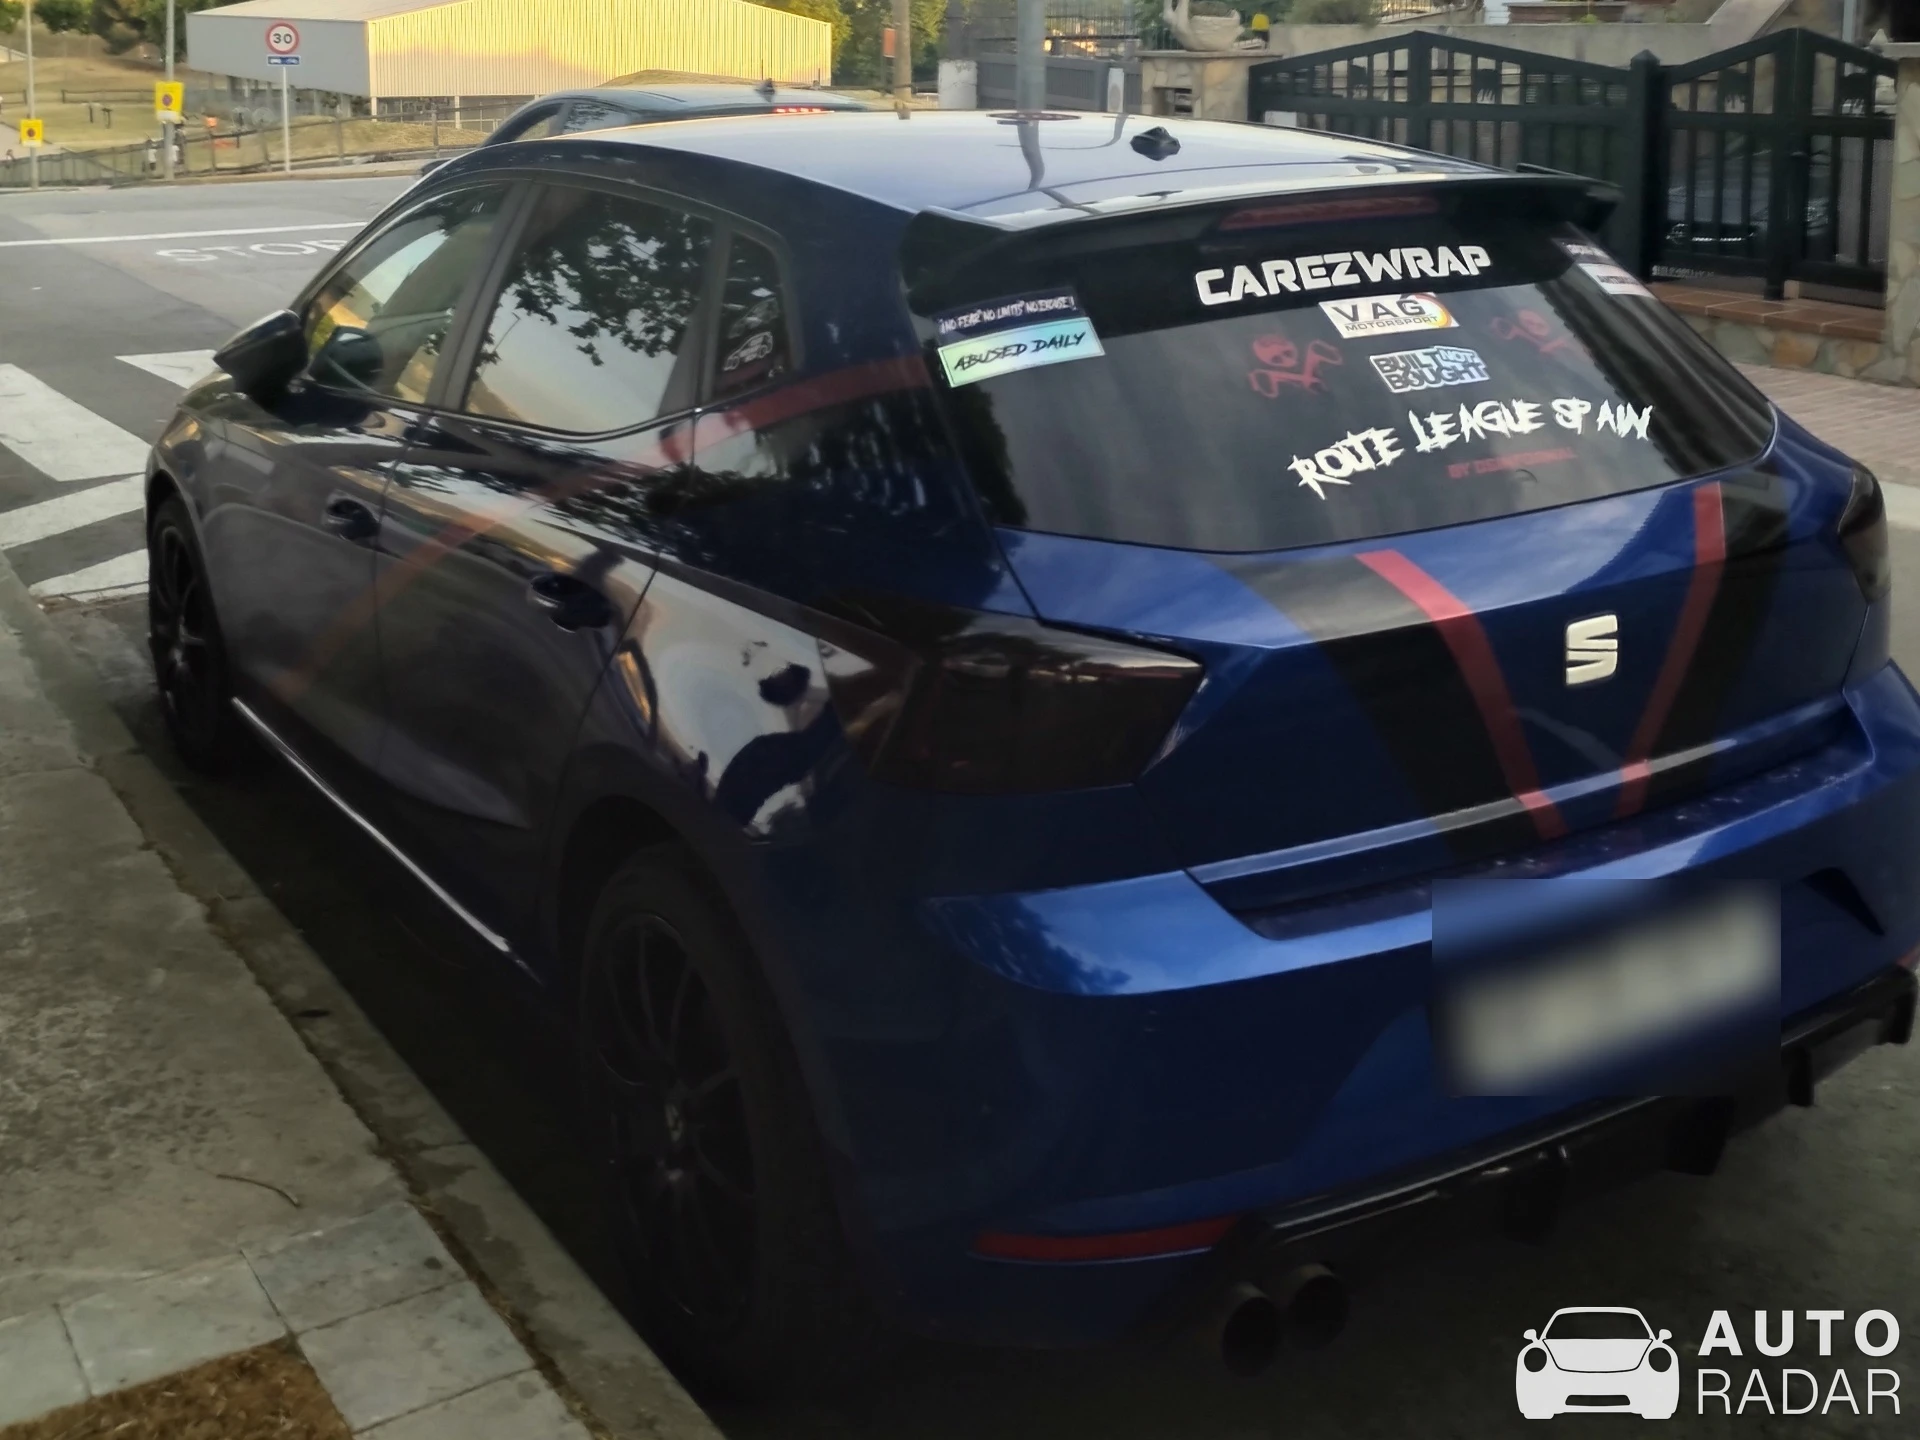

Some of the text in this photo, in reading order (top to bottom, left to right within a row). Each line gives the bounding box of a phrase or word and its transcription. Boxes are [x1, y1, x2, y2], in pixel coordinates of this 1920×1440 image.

[273, 33, 293, 44] 30
[156, 239, 348, 262] STOP
[1195, 245, 1492, 306] CAREZWRAP
[1332, 299, 1426, 322] VAG
[1345, 315, 1438, 332] MOTORSPORT
[954, 332, 1086, 371] ABUSED DAILY
[1374, 350, 1436, 374] BUILT
[1441, 349, 1475, 364] NOT
[1383, 364, 1488, 390] BOUGHT
[1287, 427, 1404, 500] ROUTE
[1408, 398, 1546, 452] LEAGUE
